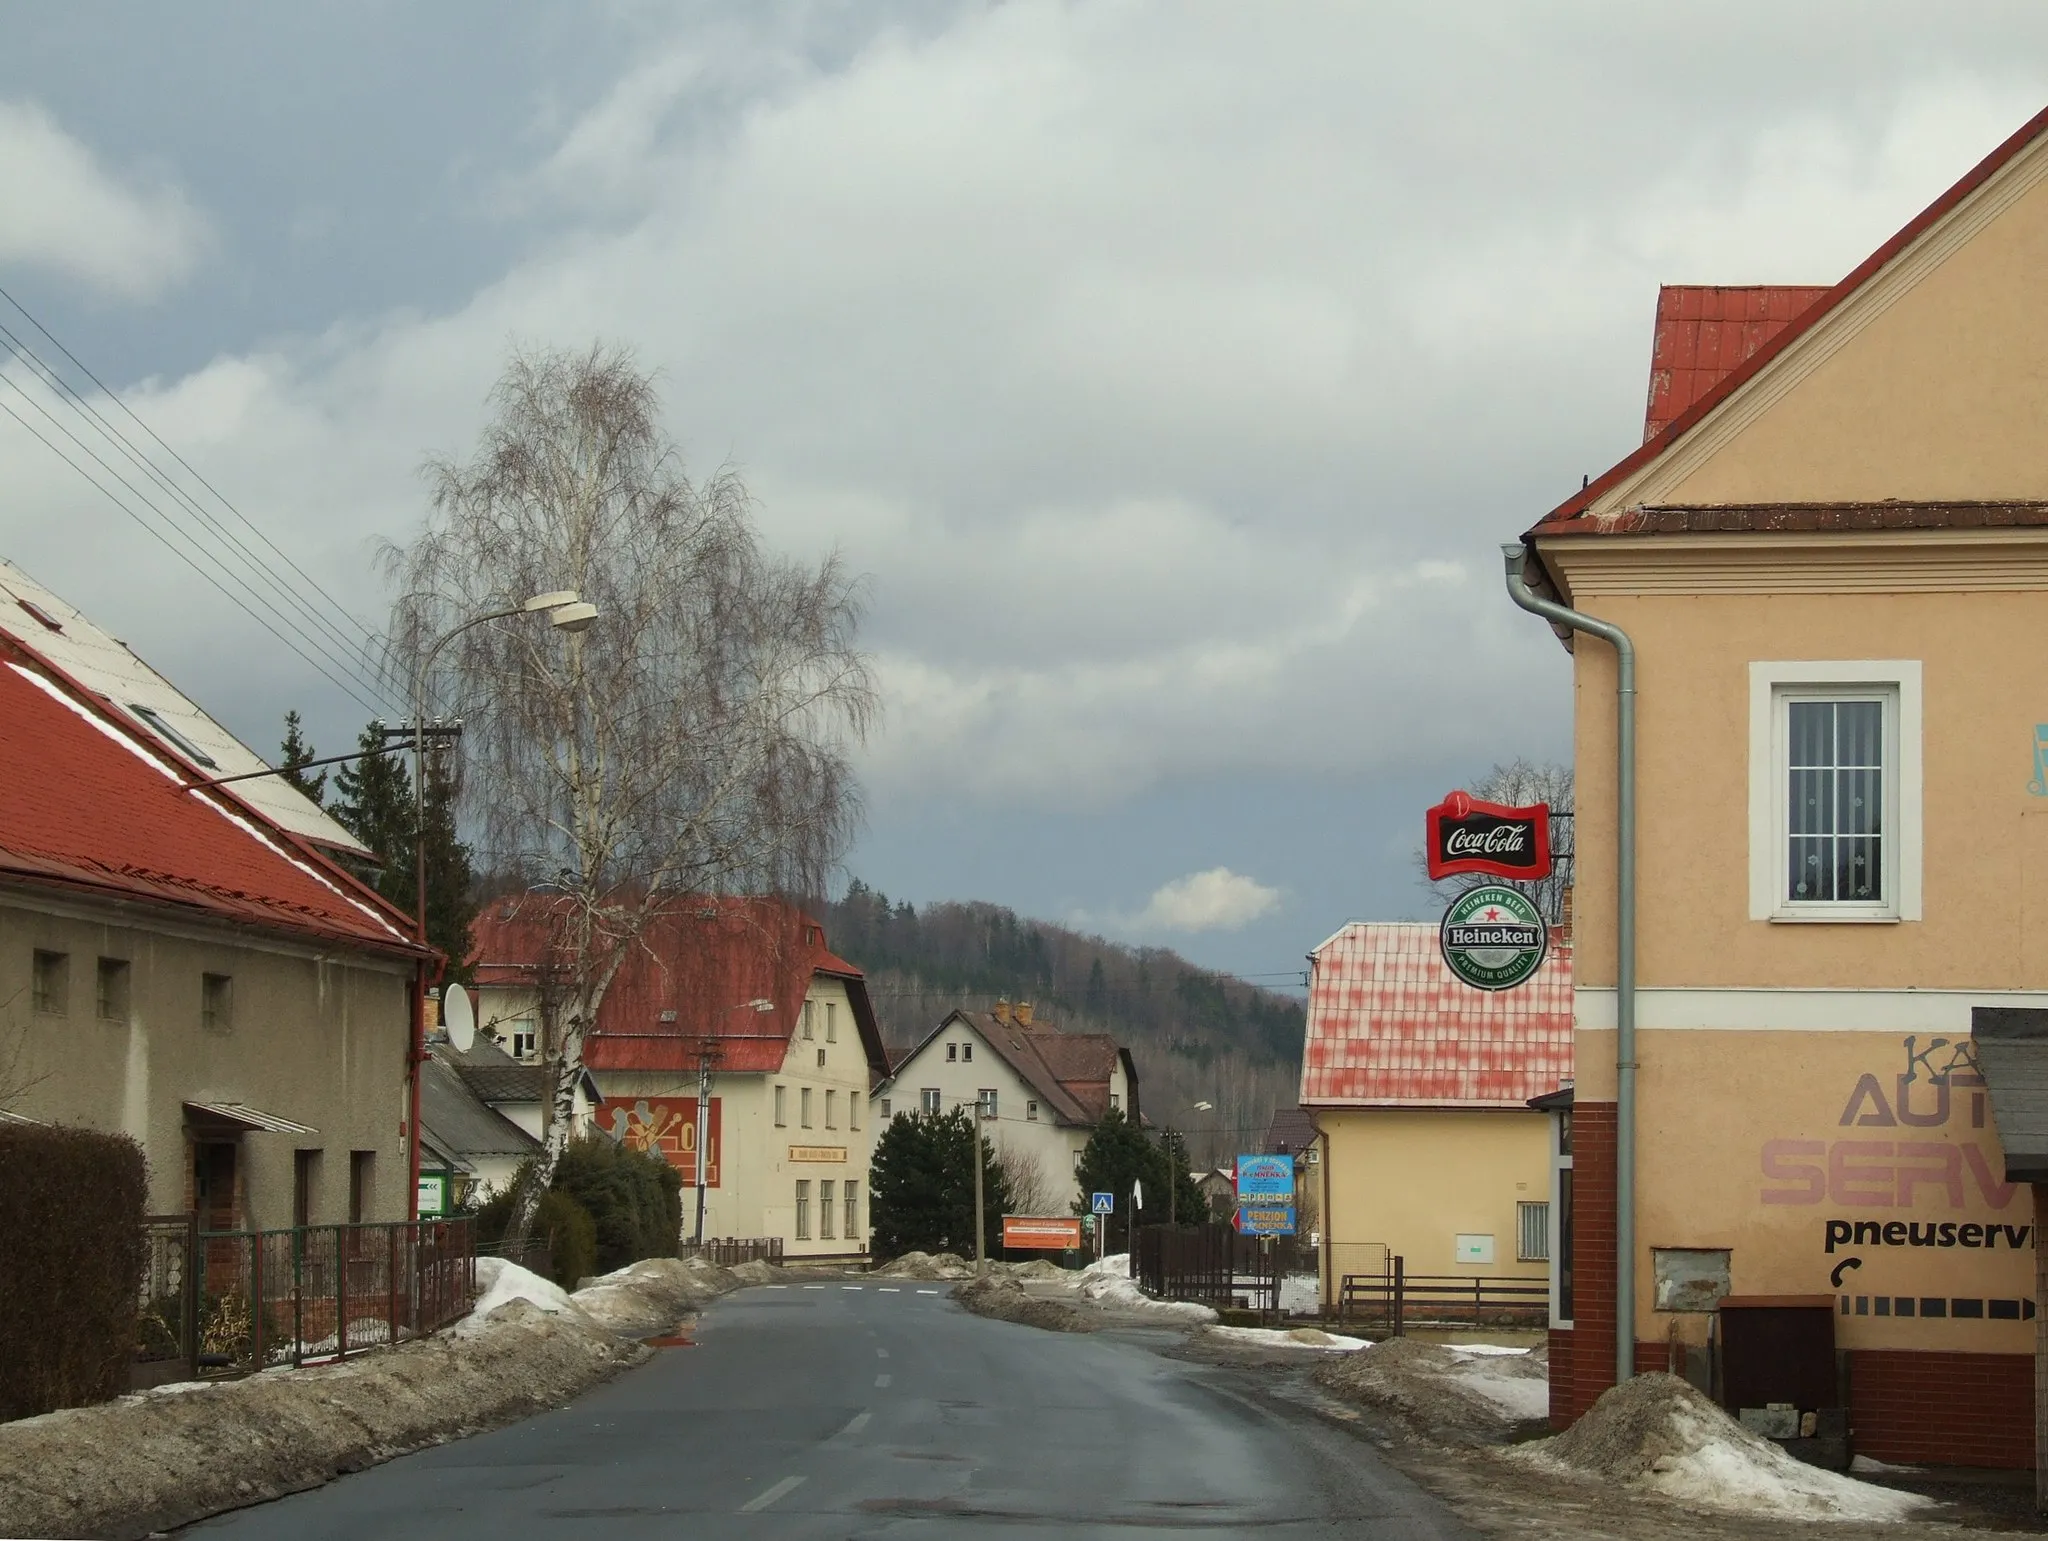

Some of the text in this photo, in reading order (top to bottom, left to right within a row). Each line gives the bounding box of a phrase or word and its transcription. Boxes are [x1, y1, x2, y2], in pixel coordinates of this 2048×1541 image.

[1447, 825, 1527, 855] Coca-Cola
[1460, 894, 1526, 915] HEINEKEN BEER
[1452, 928, 1534, 944] Heineken
[1458, 955, 1529, 979] PREMIUM QUALITY
[1247, 1211, 1288, 1221] PENZION
[1824, 1217, 2036, 1254] pneuserv
